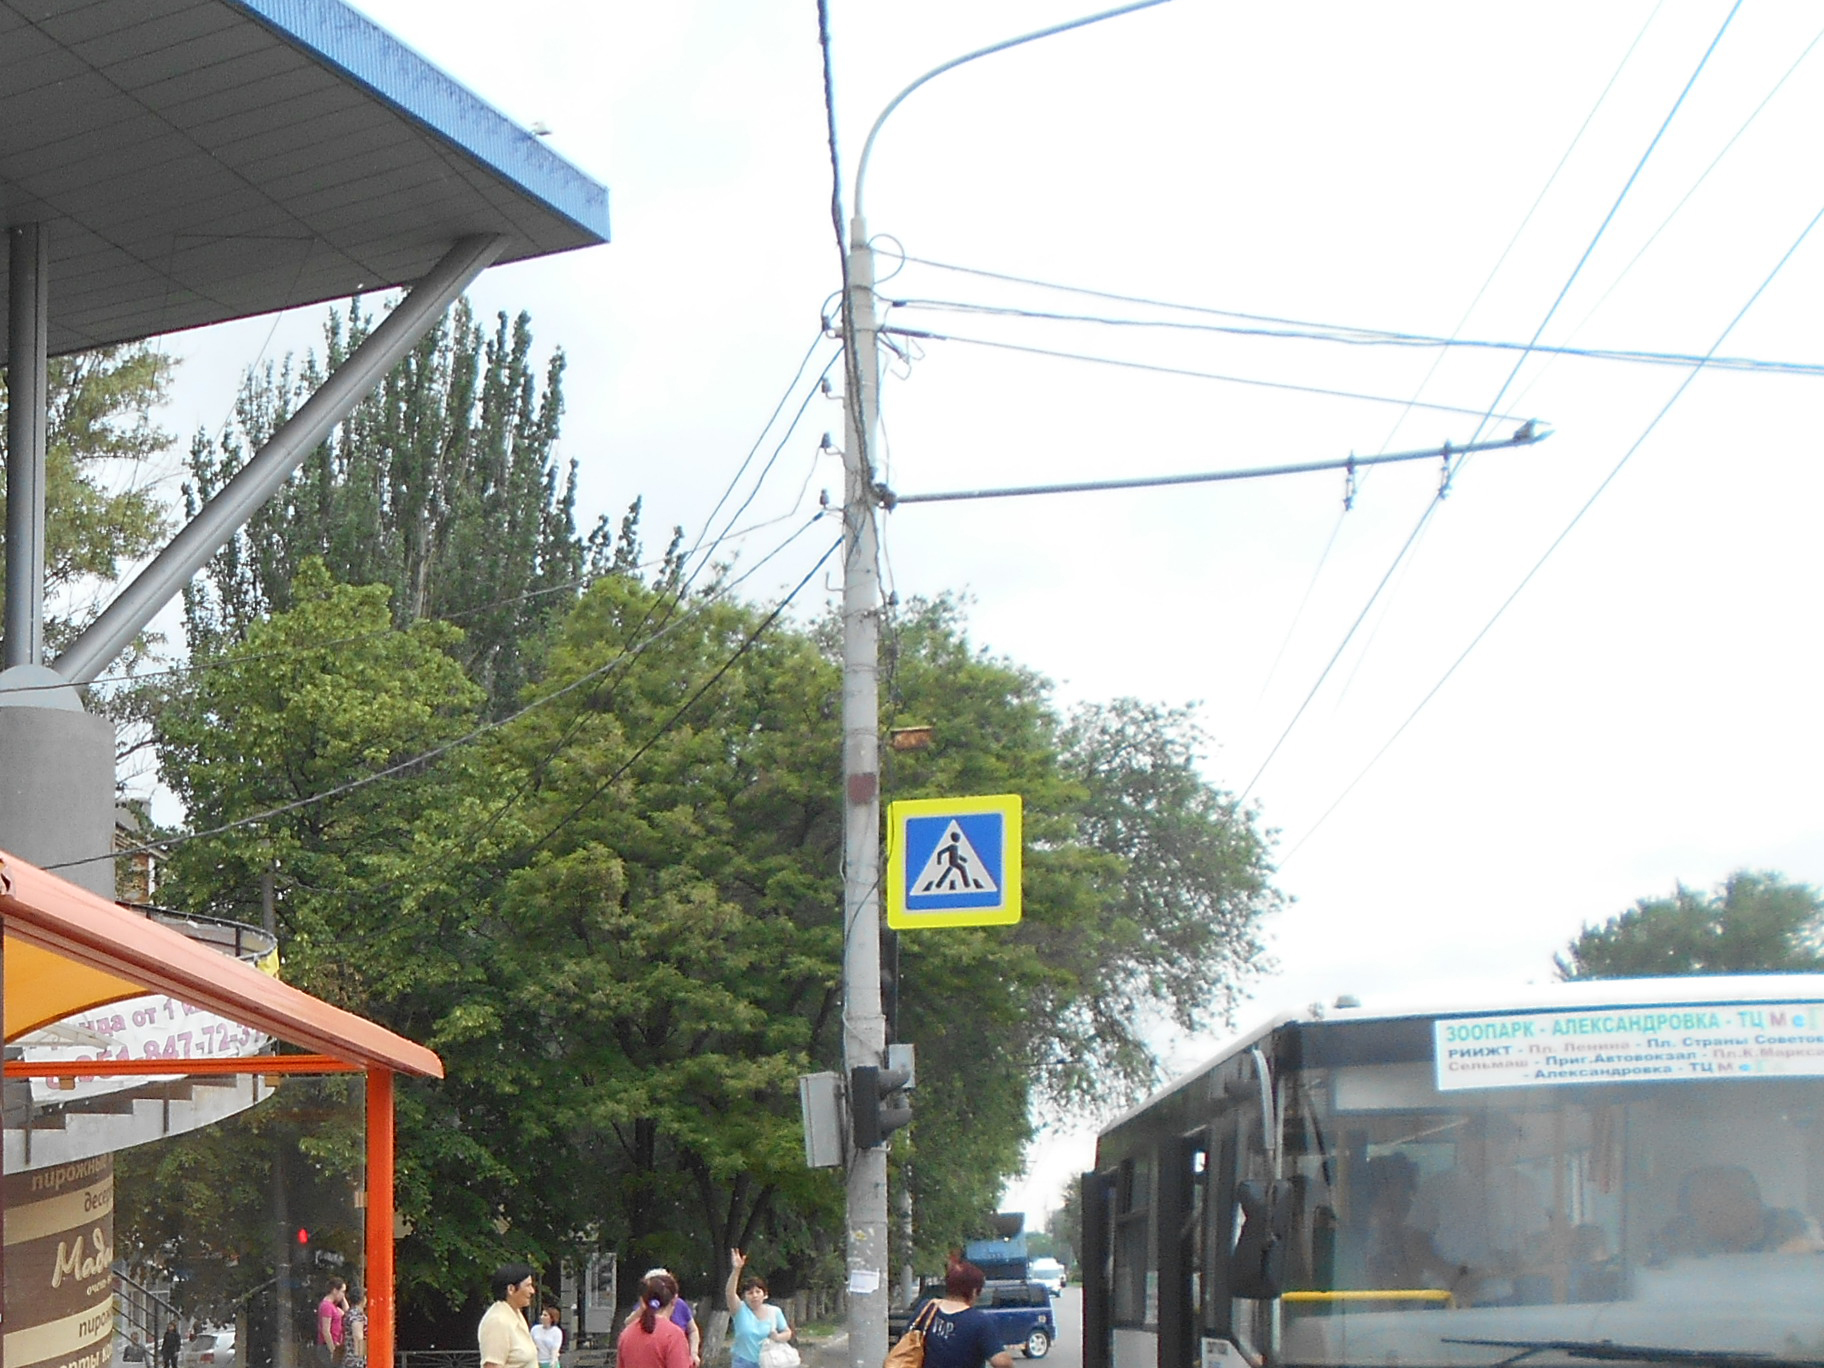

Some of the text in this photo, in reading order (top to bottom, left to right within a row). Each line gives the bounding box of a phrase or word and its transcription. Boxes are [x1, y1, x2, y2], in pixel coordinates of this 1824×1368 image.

[132, 1008, 157, 1027] от
[1446, 1021, 1535, 1042] ЗООПАРК
[1552, 1013, 1720, 1036] АЛЕКСАНДРОВКА
